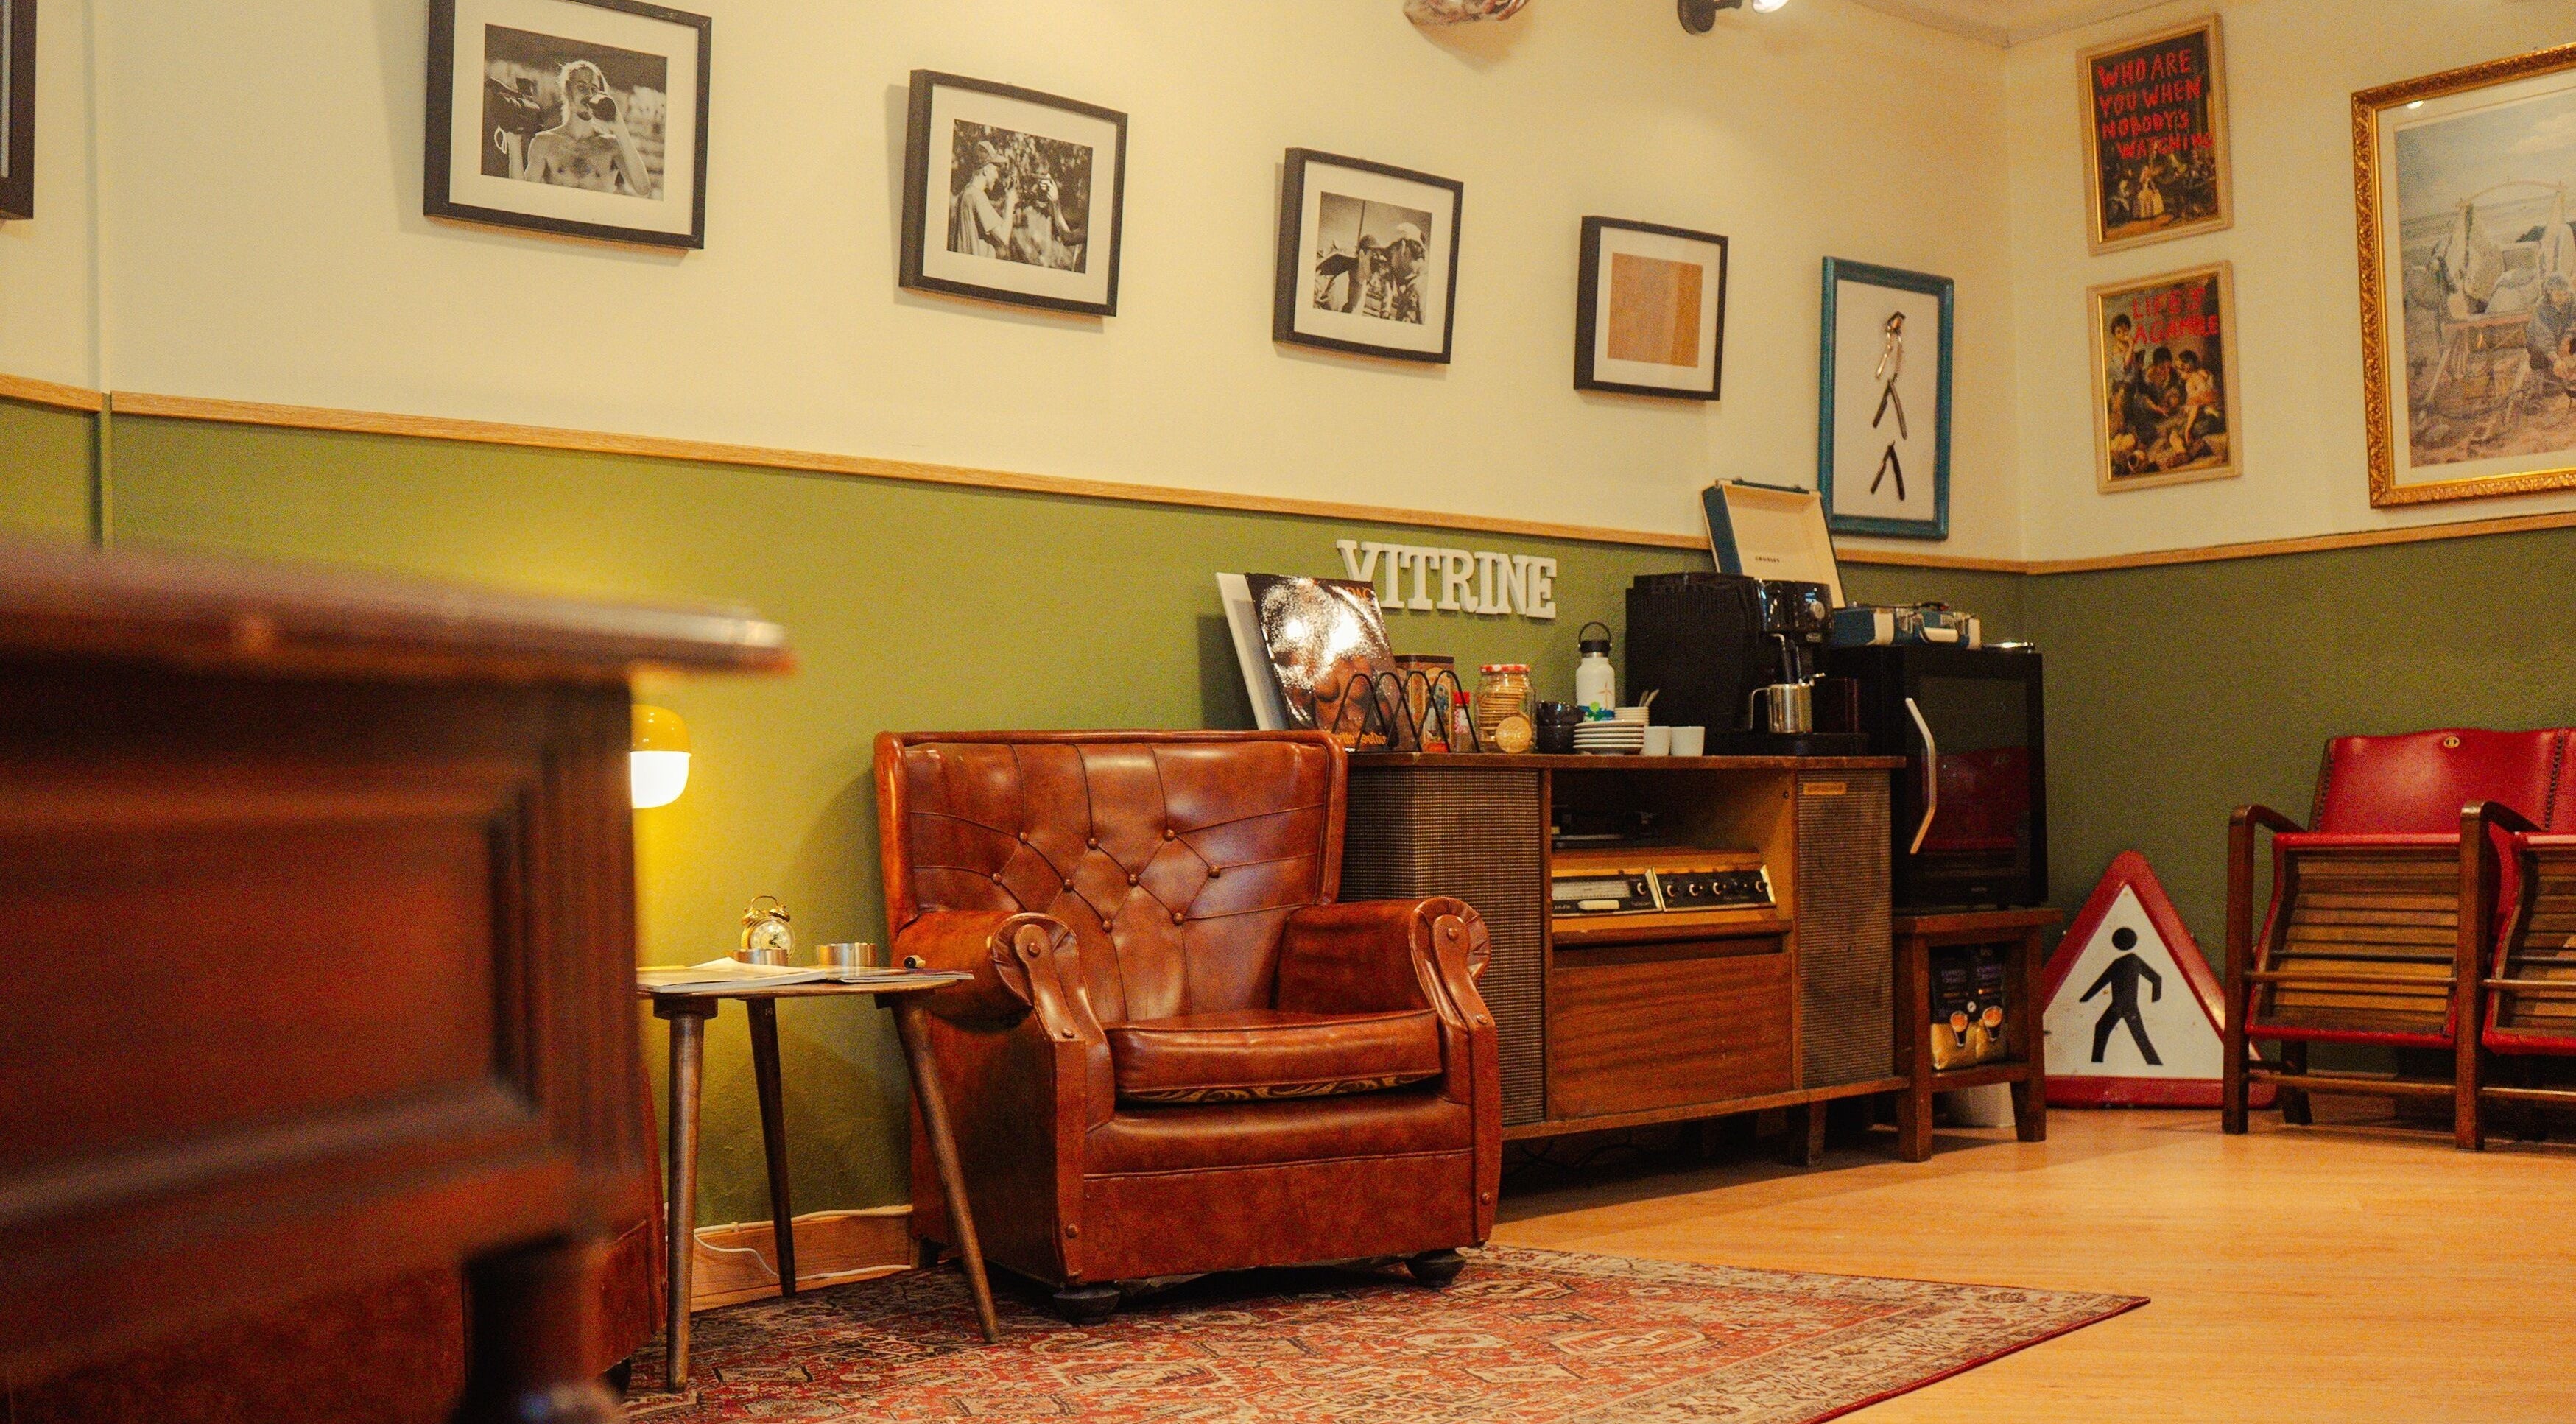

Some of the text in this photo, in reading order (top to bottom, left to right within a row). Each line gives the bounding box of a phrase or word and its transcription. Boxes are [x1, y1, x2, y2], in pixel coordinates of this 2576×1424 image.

[2098, 49, 2192, 89] WHO ARE
[2100, 75, 2200, 117] YOU WHEN
[1337, 540, 1556, 618] VITRINE
